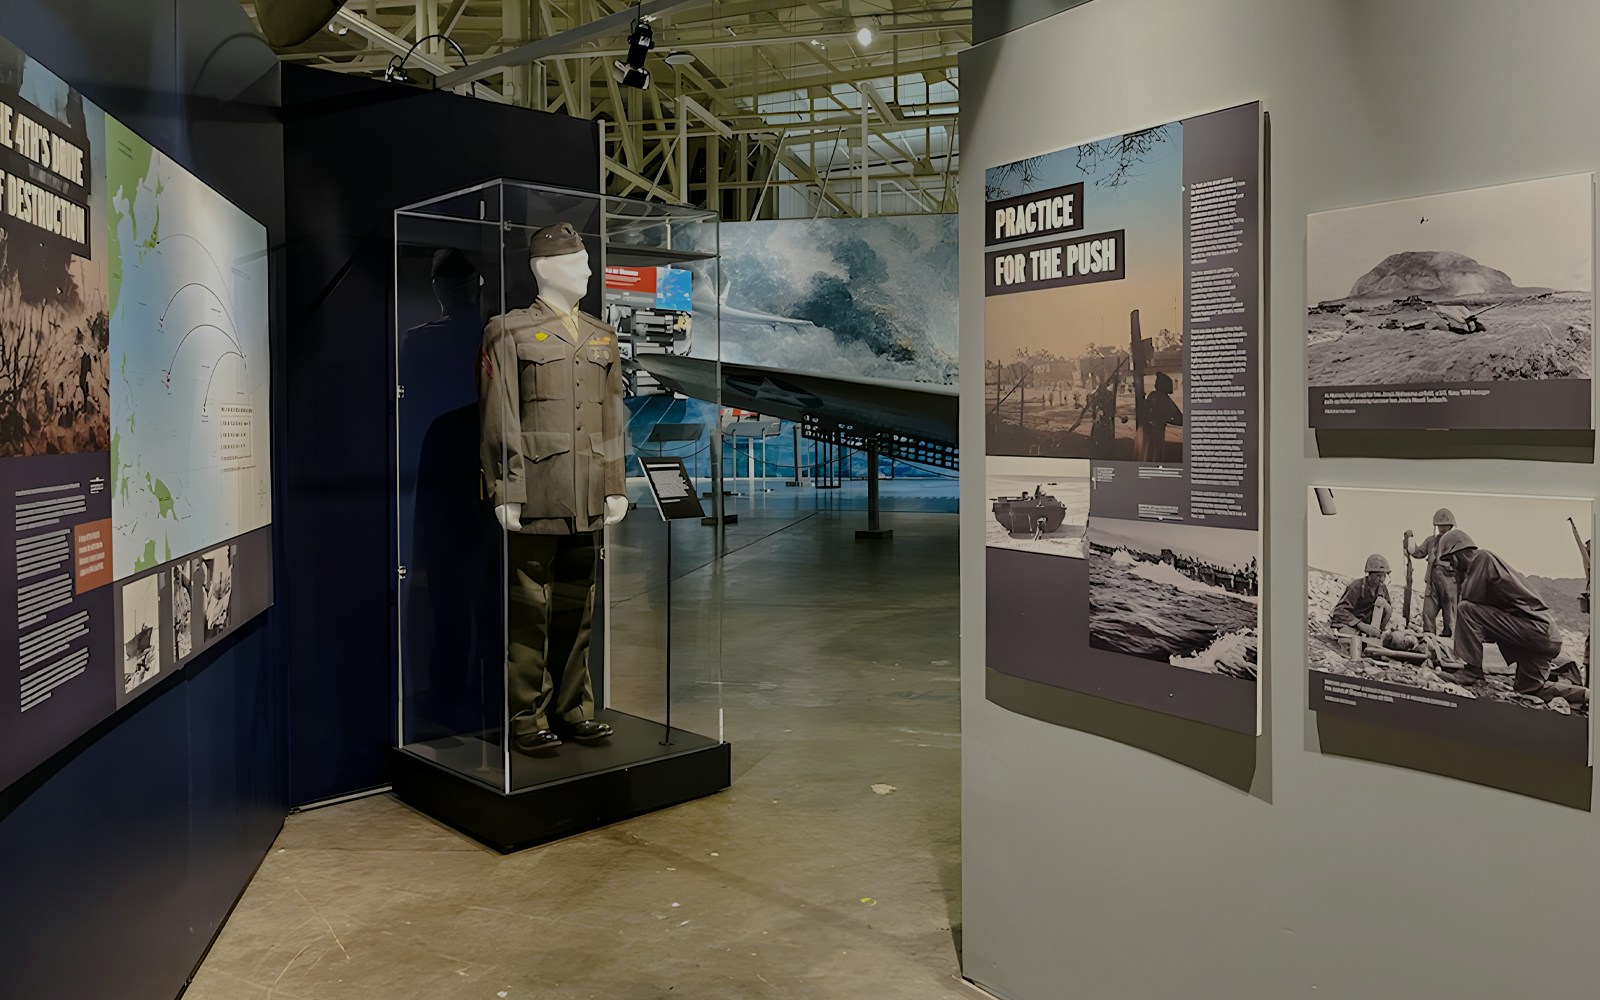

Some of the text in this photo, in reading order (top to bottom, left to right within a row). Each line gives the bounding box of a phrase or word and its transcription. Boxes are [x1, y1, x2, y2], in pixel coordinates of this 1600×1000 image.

[15, 113, 50, 169] 4TH'S
[51, 133, 84, 187] DRIVE
[7, 172, 86, 245] DESTRUCTION
[995, 193, 1074, 240] PRACTICE
[995, 237, 1116, 286] FOR THE PUSH
